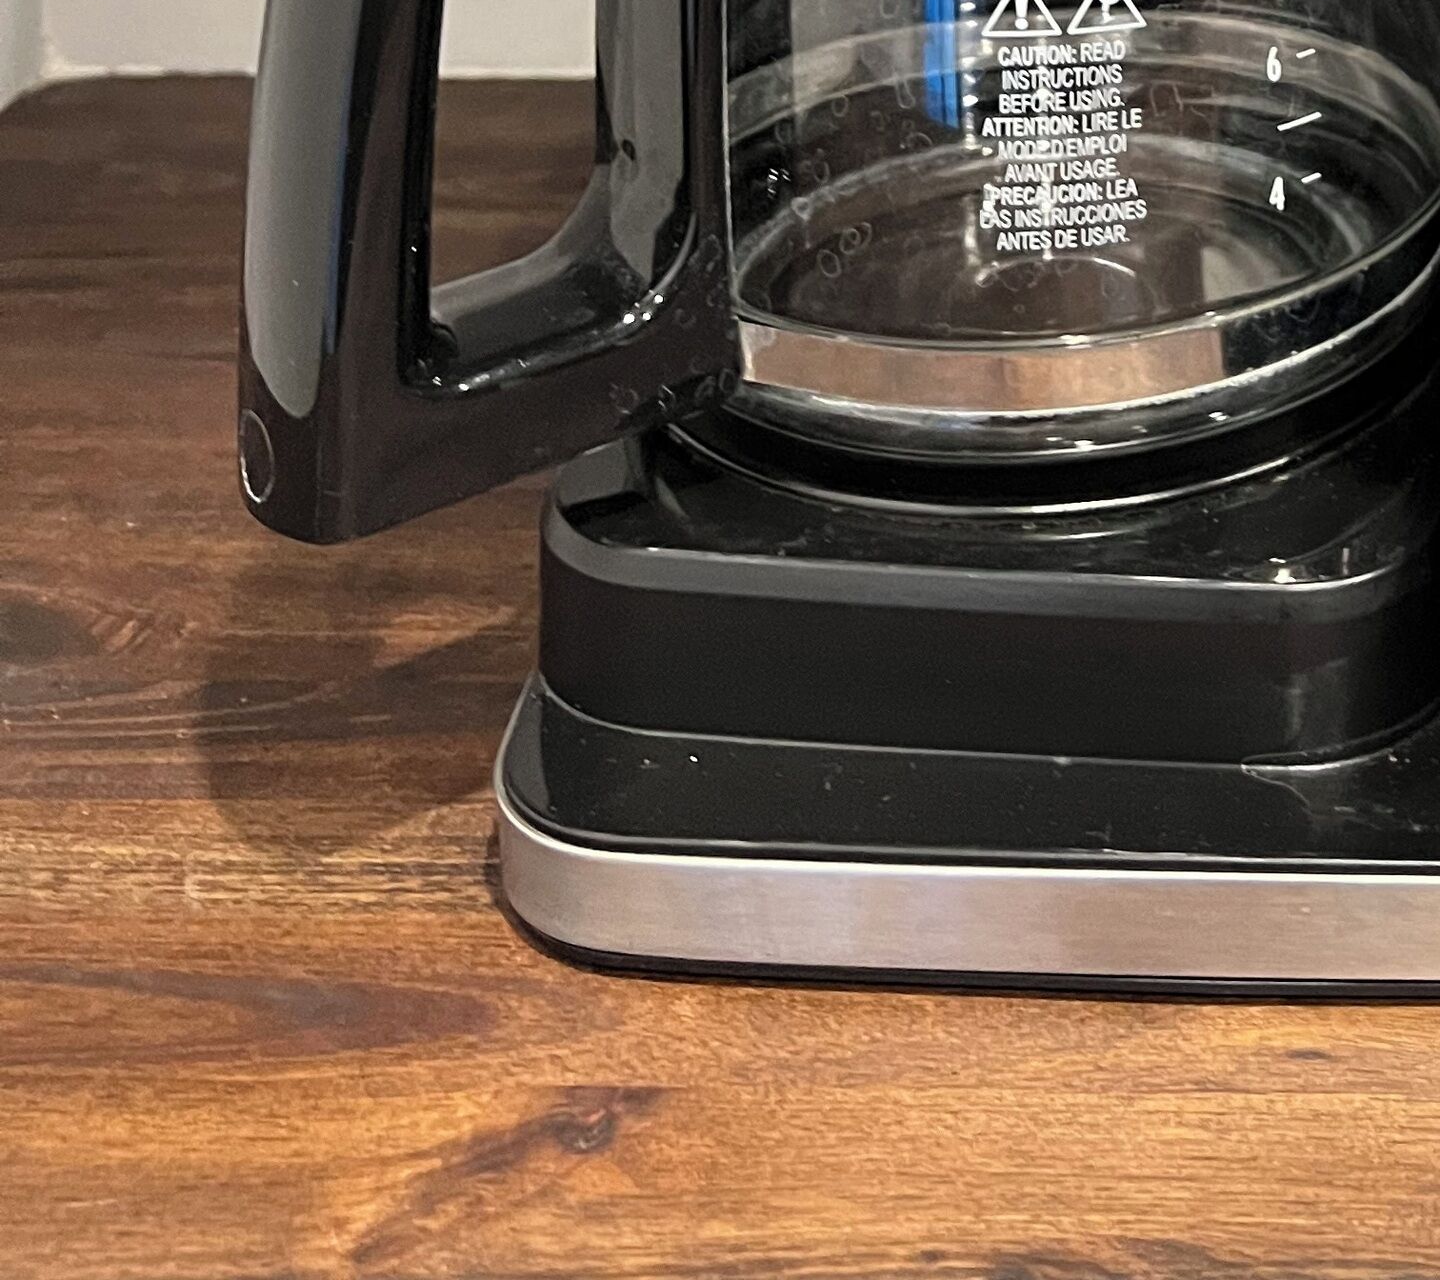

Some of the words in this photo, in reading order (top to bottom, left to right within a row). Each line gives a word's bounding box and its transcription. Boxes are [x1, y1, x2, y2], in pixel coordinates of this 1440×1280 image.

[997, 44, 1077, 67] CAUTION:
[1080, 39, 1127, 63] READ
[1265, 46, 1282, 83] 6
[1001, 64, 1123, 90] INSTRUCTIONS
[998, 91, 1067, 114] BEFORE
[982, 114, 1080, 137] ATTENTION:
[1082, 110, 1119, 133] LIRE
[1121, 108, 1143, 129] LE
[1004, 161, 1058, 183] AVANT
[1106, 178, 1138, 200] LEA
[1269, 177, 1286, 212] 4
[997, 230, 1053, 251] ANTES
[1055, 228, 1078, 248] DE
